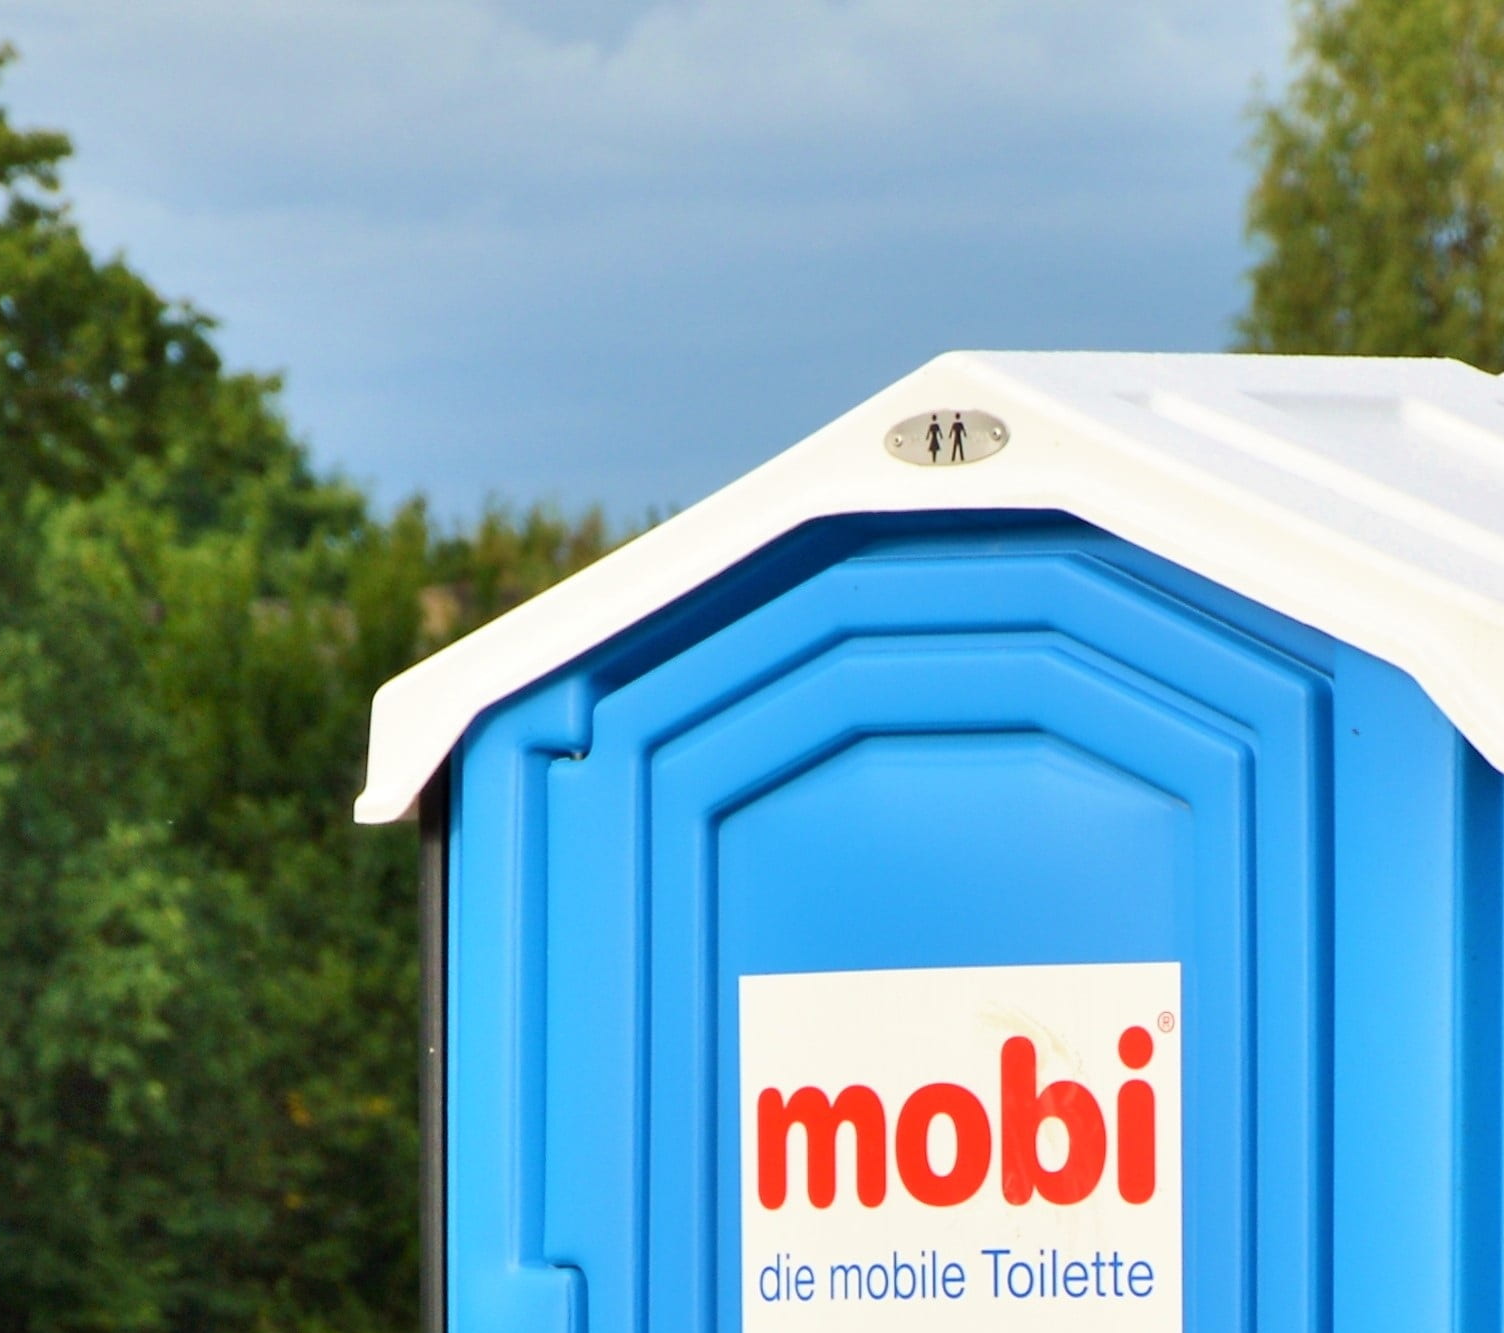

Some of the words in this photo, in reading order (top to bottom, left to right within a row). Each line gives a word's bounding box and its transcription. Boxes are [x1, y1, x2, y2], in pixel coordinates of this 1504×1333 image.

[757, 1026, 1157, 1211] mobi
[758, 1252, 816, 1302] die
[828, 1249, 967, 1301] mobile
[980, 1248, 1155, 1299] Toilette
